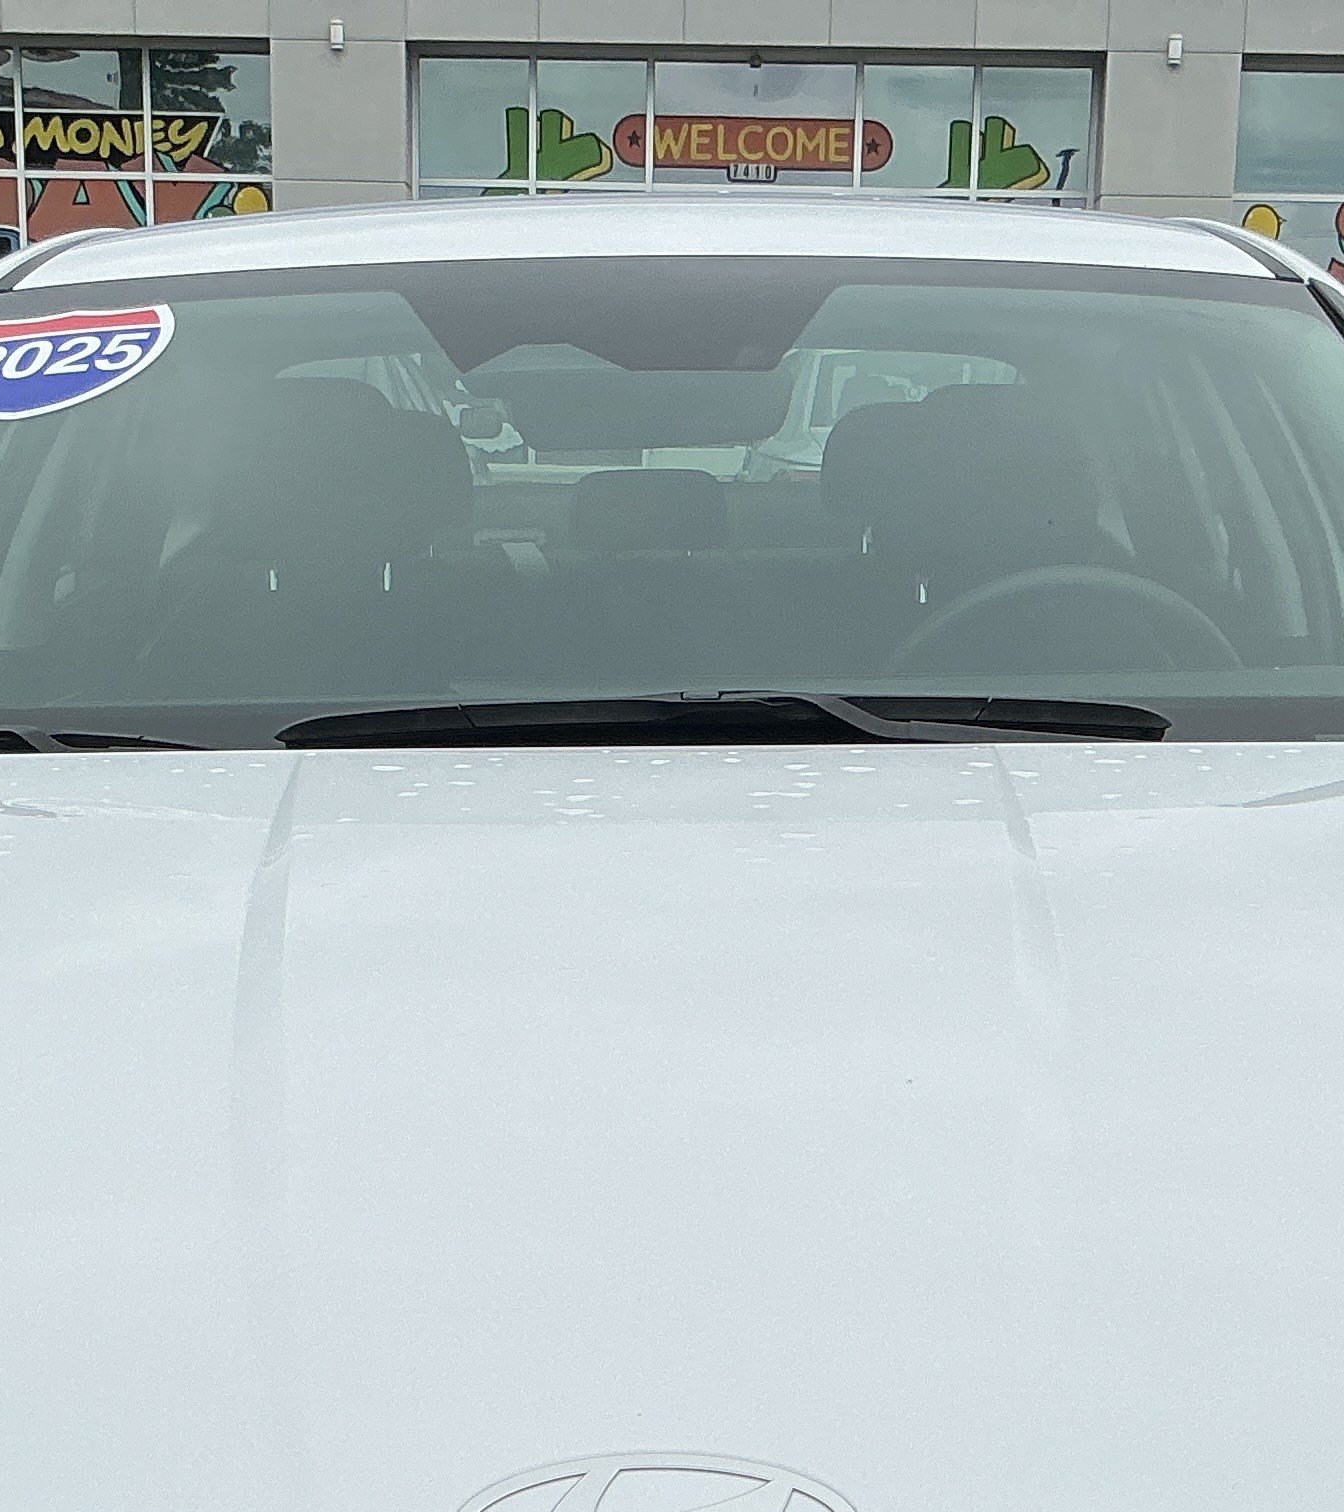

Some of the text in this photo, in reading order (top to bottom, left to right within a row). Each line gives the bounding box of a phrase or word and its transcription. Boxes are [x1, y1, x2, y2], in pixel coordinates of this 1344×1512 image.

[11, 117, 209, 163] MONEY
[654, 123, 851, 163] WELCOME
[731, 163, 773, 180] 7410
